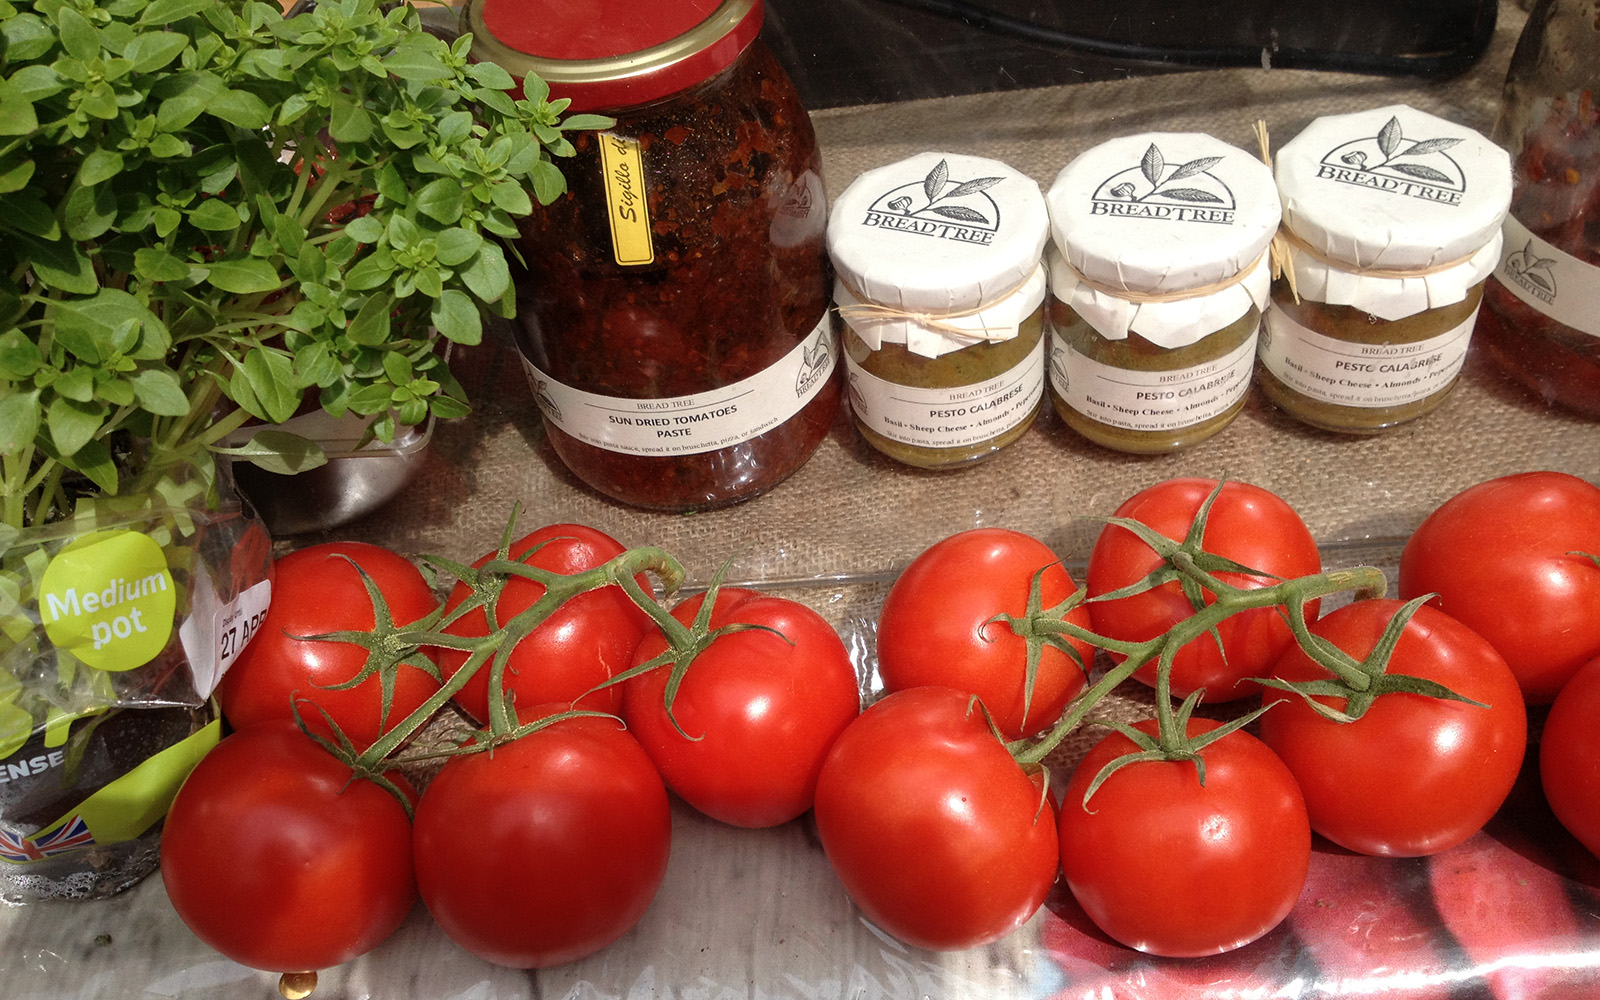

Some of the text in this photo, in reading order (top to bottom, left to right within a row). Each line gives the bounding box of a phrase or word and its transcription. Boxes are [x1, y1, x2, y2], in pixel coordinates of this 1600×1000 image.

[614, 162, 638, 223] Sigillo
[1400, 344, 1424, 354] TREE
[1160, 365, 1218, 383] BREAD TREE
[1285, 357, 1302, 372] Basil
[1310, 370, 1336, 384] Sheep
[1340, 379, 1372, 388] Cheese
[1381, 377, 1421, 388] Almonds
[930, 408, 966, 418] PESTO
[970, 383, 1023, 414] CALABRESE
[950, 381, 1005, 400] BREAD TREE
[1137, 391, 1174, 401] PESTO
[637, 399, 695, 410] BREAD TREE
[1086, 395, 1105, 408] Basil
[1113, 405, 1139, 416] Sheep
[1142, 408, 1174, 416] Cheese
[1184, 396, 1218, 411] Almonds
[609, 405, 738, 426] SUN DRIED TOMATOES
[750, 417, 778, 434] sandwich
[884, 416, 902, 428] Basil
[910, 424, 934, 433] Sheep
[938, 425, 967, 433] Cheese
[975, 410, 1009, 427] Almonds
[1135, 422, 1158, 430] spread
[657, 428, 692, 438] PASTE
[45, 572, 167, 620] Medium
[92, 606, 147, 650] pot
[221, 627, 236, 660] 27
[0, 750, 64, 783] ENSE
